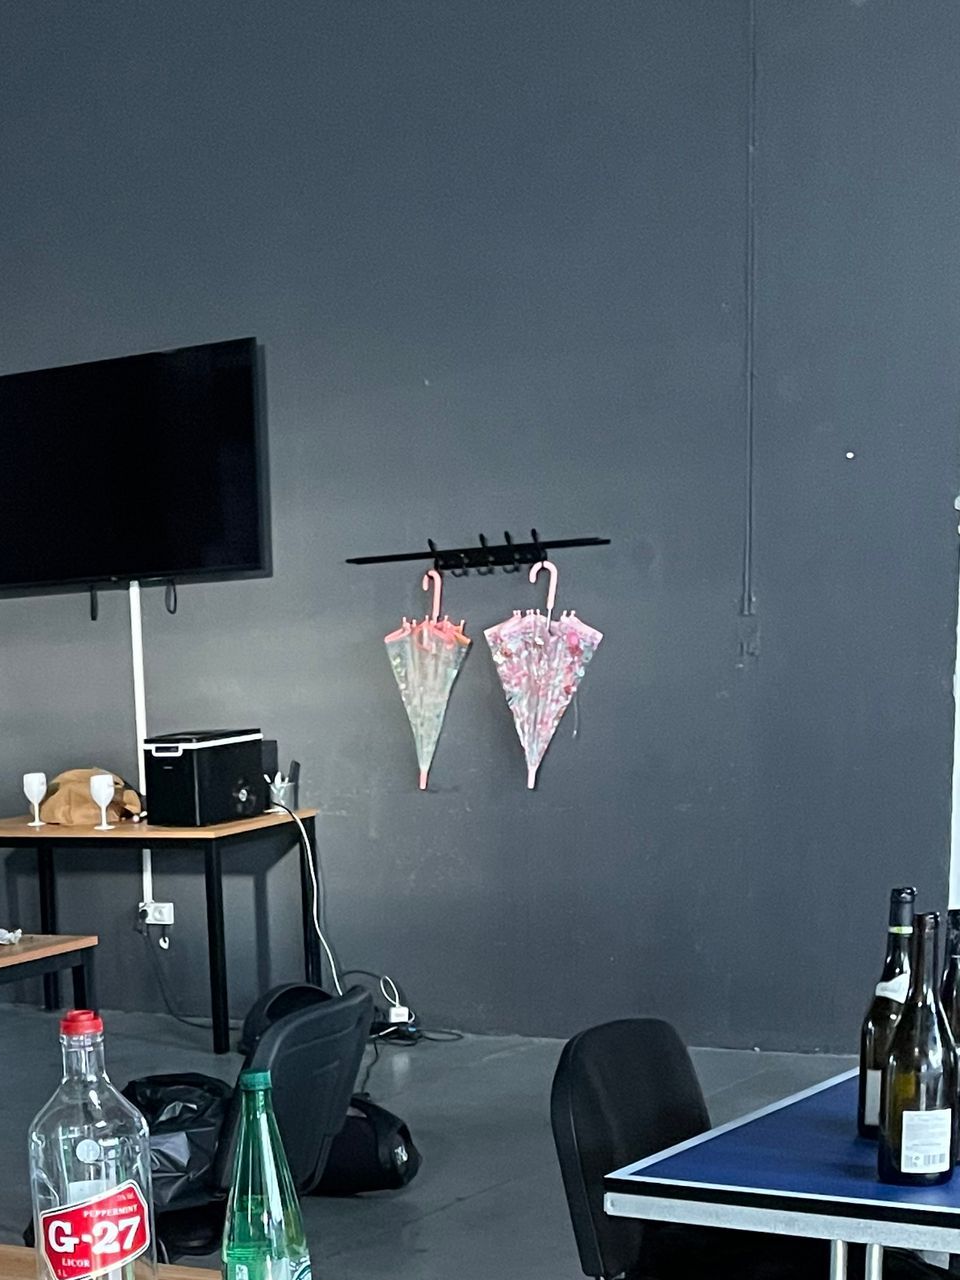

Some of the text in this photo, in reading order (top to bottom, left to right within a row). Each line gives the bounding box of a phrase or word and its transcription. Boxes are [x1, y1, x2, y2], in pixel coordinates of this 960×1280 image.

[83, 1204, 138, 1218] PEPPERMINT
[48, 1215, 141, 1256] G-27
[62, 1257, 90, 1268] LICOR
